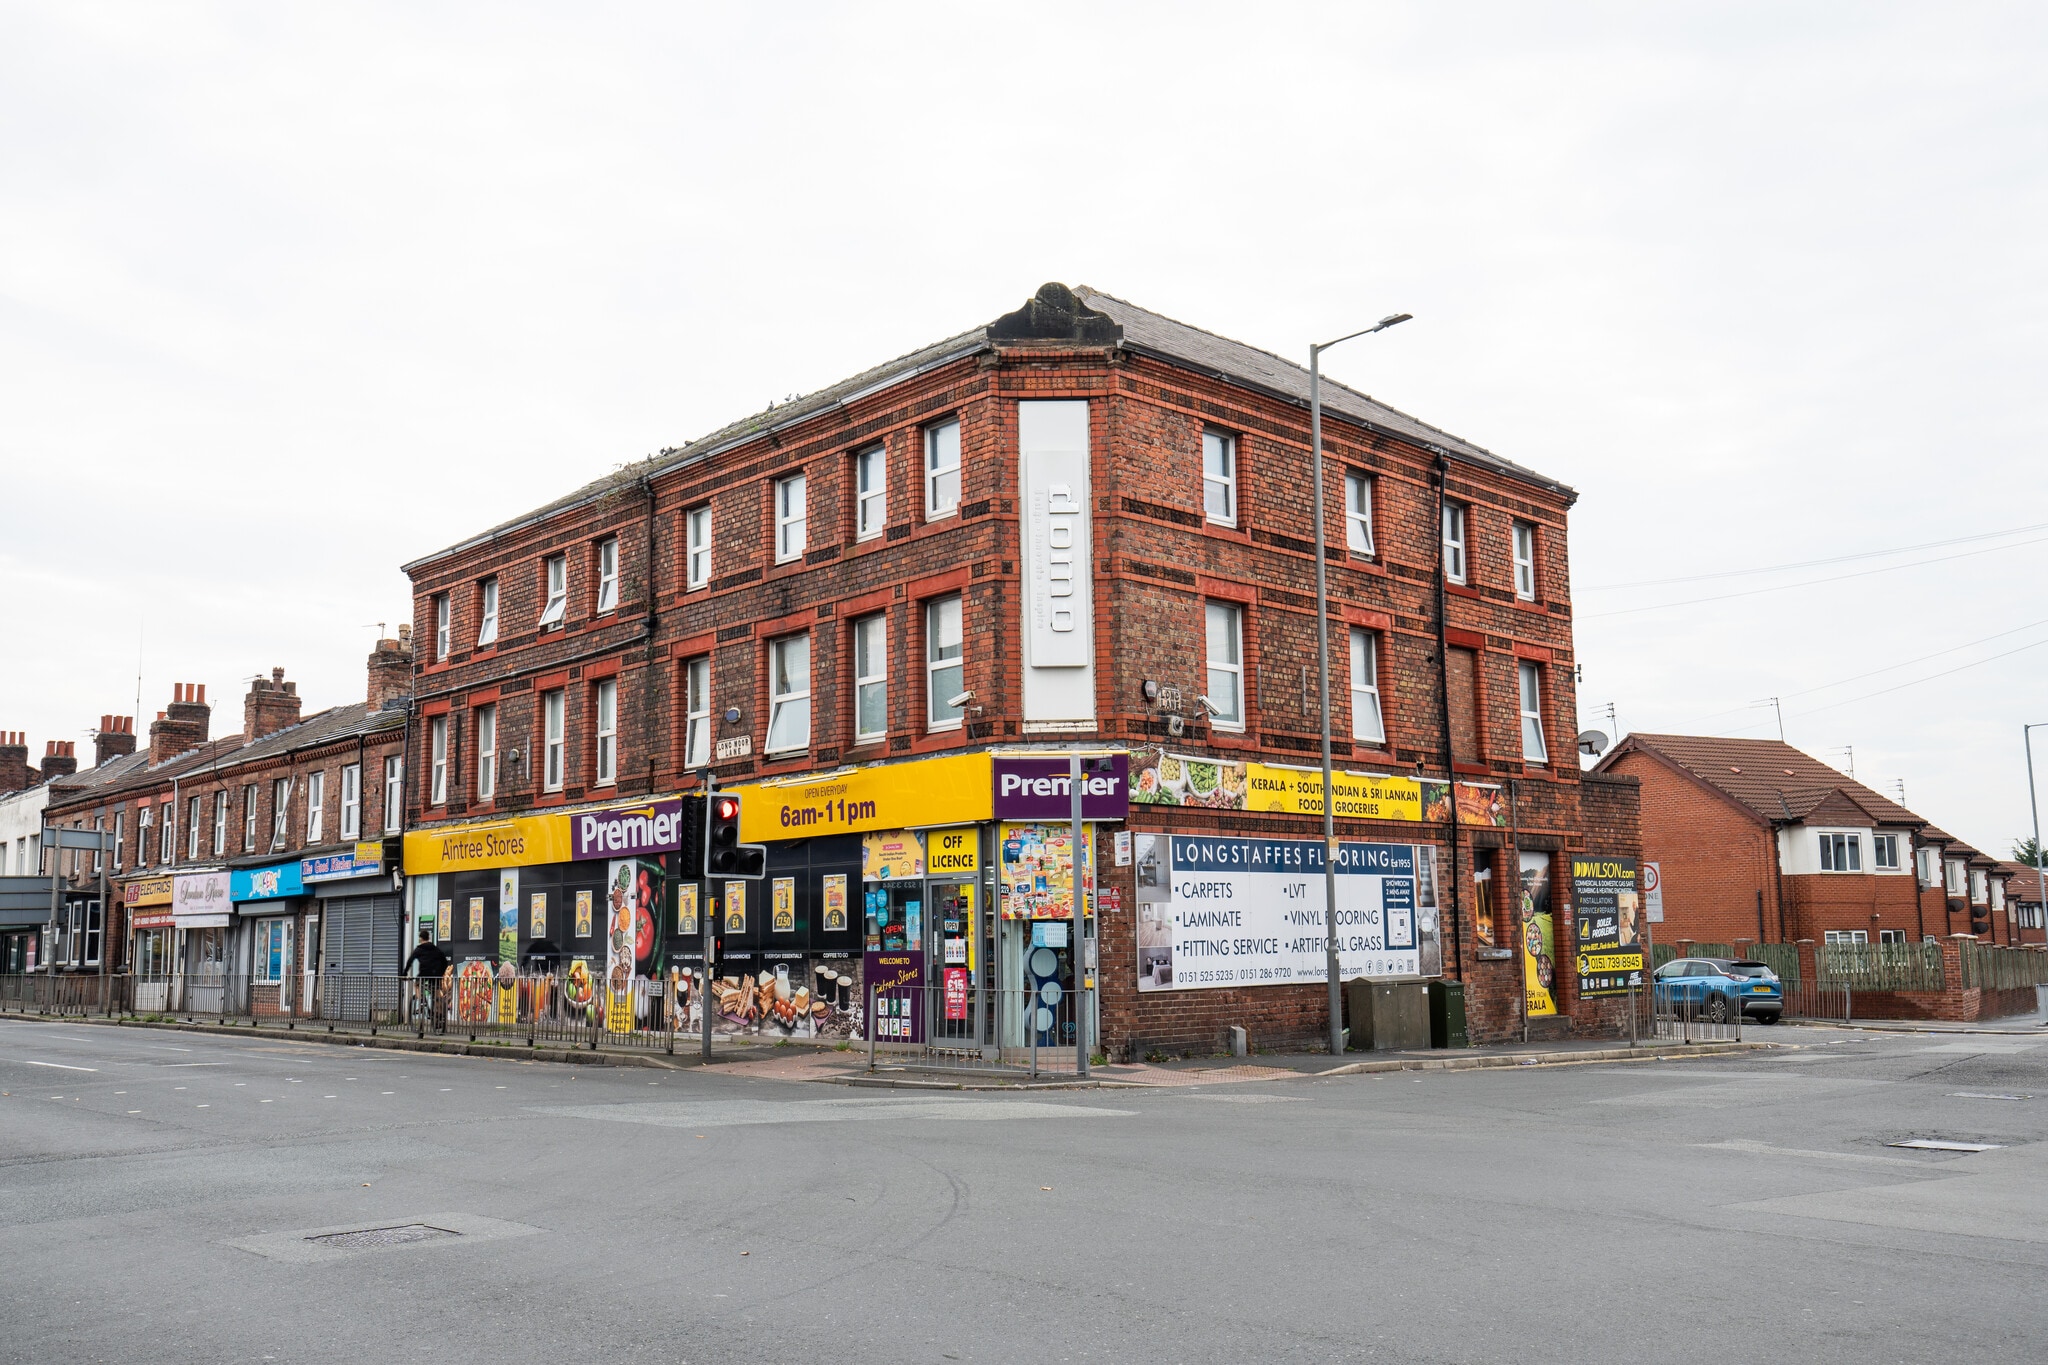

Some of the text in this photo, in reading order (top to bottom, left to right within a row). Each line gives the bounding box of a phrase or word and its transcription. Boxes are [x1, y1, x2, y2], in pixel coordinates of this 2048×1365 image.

[1048, 484, 1080, 632] domo
[1161, 700, 1180, 710] LANE
[733, 738, 749, 748] MOOR
[725, 747, 741, 757] LANE
[804, 783, 848, 799] OPEN EVERYDAY
[1001, 773, 1120, 797] Premier
[1251, 778, 1286, 792] KERALA
[1297, 781, 1324, 796] SOUTH
[1331, 785, 1360, 798] NDIAN
[1362, 787, 1368, 799] &
[1370, 788, 1383, 799] SRI
[1384, 789, 1418, 802] LANKAN
[780, 798, 876, 828] 6am-11pm
[1298, 798, 1379, 815] FOOD GROCERIES
[581, 807, 682, 854] Premier
[441, 833, 525, 861] Aintree Stores
[943, 835, 963, 849] OFF
[932, 854, 973, 868] LICENCE
[1176, 843, 1302, 865] LONGSTAFFES
[1308, 848, 1389, 868] FLORING
[302, 862, 313, 875] The
[314, 859, 330, 874] Good
[140, 880, 172, 896] ELECTRICS
[1182, 881, 1233, 899] CARPETS
[1289, 883, 1307, 899] LVT
[946, 921, 958, 930] OPEN
[1183, 911, 1242, 928] LAMINATE
[1290, 909, 1379, 926] VINYL FOORING
[885, 924, 902, 934] OPEN
[1183, 938, 1278, 957] FITTING SERVICE
[1291, 935, 1382, 953] ARTIFICAL GRASS
[878, 957, 910, 965] WELCOME TO
[1590, 956, 1640, 970] 0151 739 8945
[897, 968, 918, 985] Stores
[1179, 972, 1197, 983] 0151
[1199, 970, 1214, 982] 525
[1215, 969, 1233, 981] 5235
[1240, 968, 1257, 980] 0151
[1259, 968, 1273, 979] 286
[1274, 967, 1292, 978] 9720
[947, 978, 964, 991] £15
[1527, 999, 1547, 1011] ERALA
